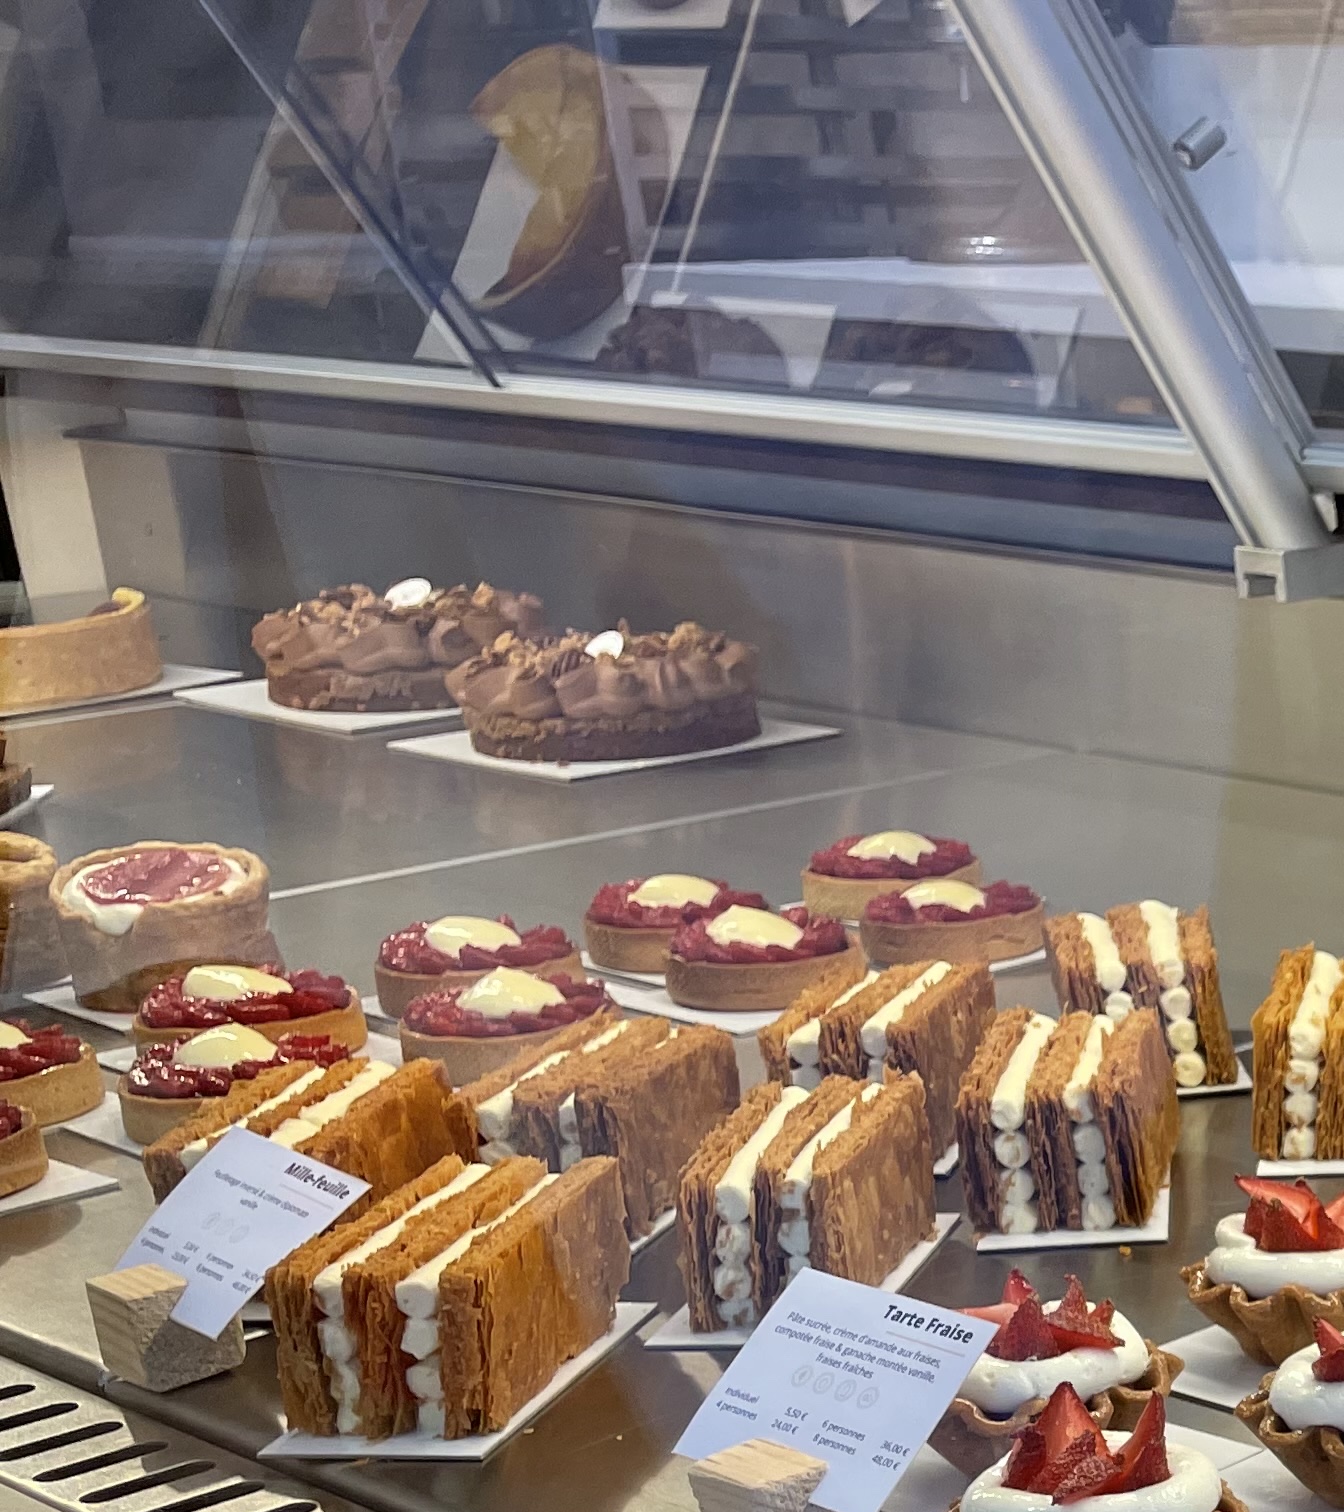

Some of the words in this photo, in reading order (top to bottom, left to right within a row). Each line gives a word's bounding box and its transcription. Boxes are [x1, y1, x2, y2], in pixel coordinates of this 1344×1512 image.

[284, 1162, 350, 1199] Mille-feuille
[833, 1328, 858, 1342] crème
[897, 1347, 913, 1358] aux
[884, 1305, 924, 1329] Tarte
[925, 1318, 973, 1343] Fraise
[813, 1334, 835, 1351] fraise
[835, 1343, 843, 1353] &
[841, 1347, 876, 1364] ganache
[878, 1358, 908, 1374] montée
[816, 1352, 842, 1369] fraises
[720, 1402, 758, 1421] personnes
[791, 1426, 799, 1435] €
[817, 1436, 856, 1455] personnes
[893, 1462, 901, 1470] €
[801, 1412, 808, 1421] €
[822, 1420, 829, 1428] 6
[826, 1423, 866, 1441] personnes
[902, 1448, 910, 1457] €
